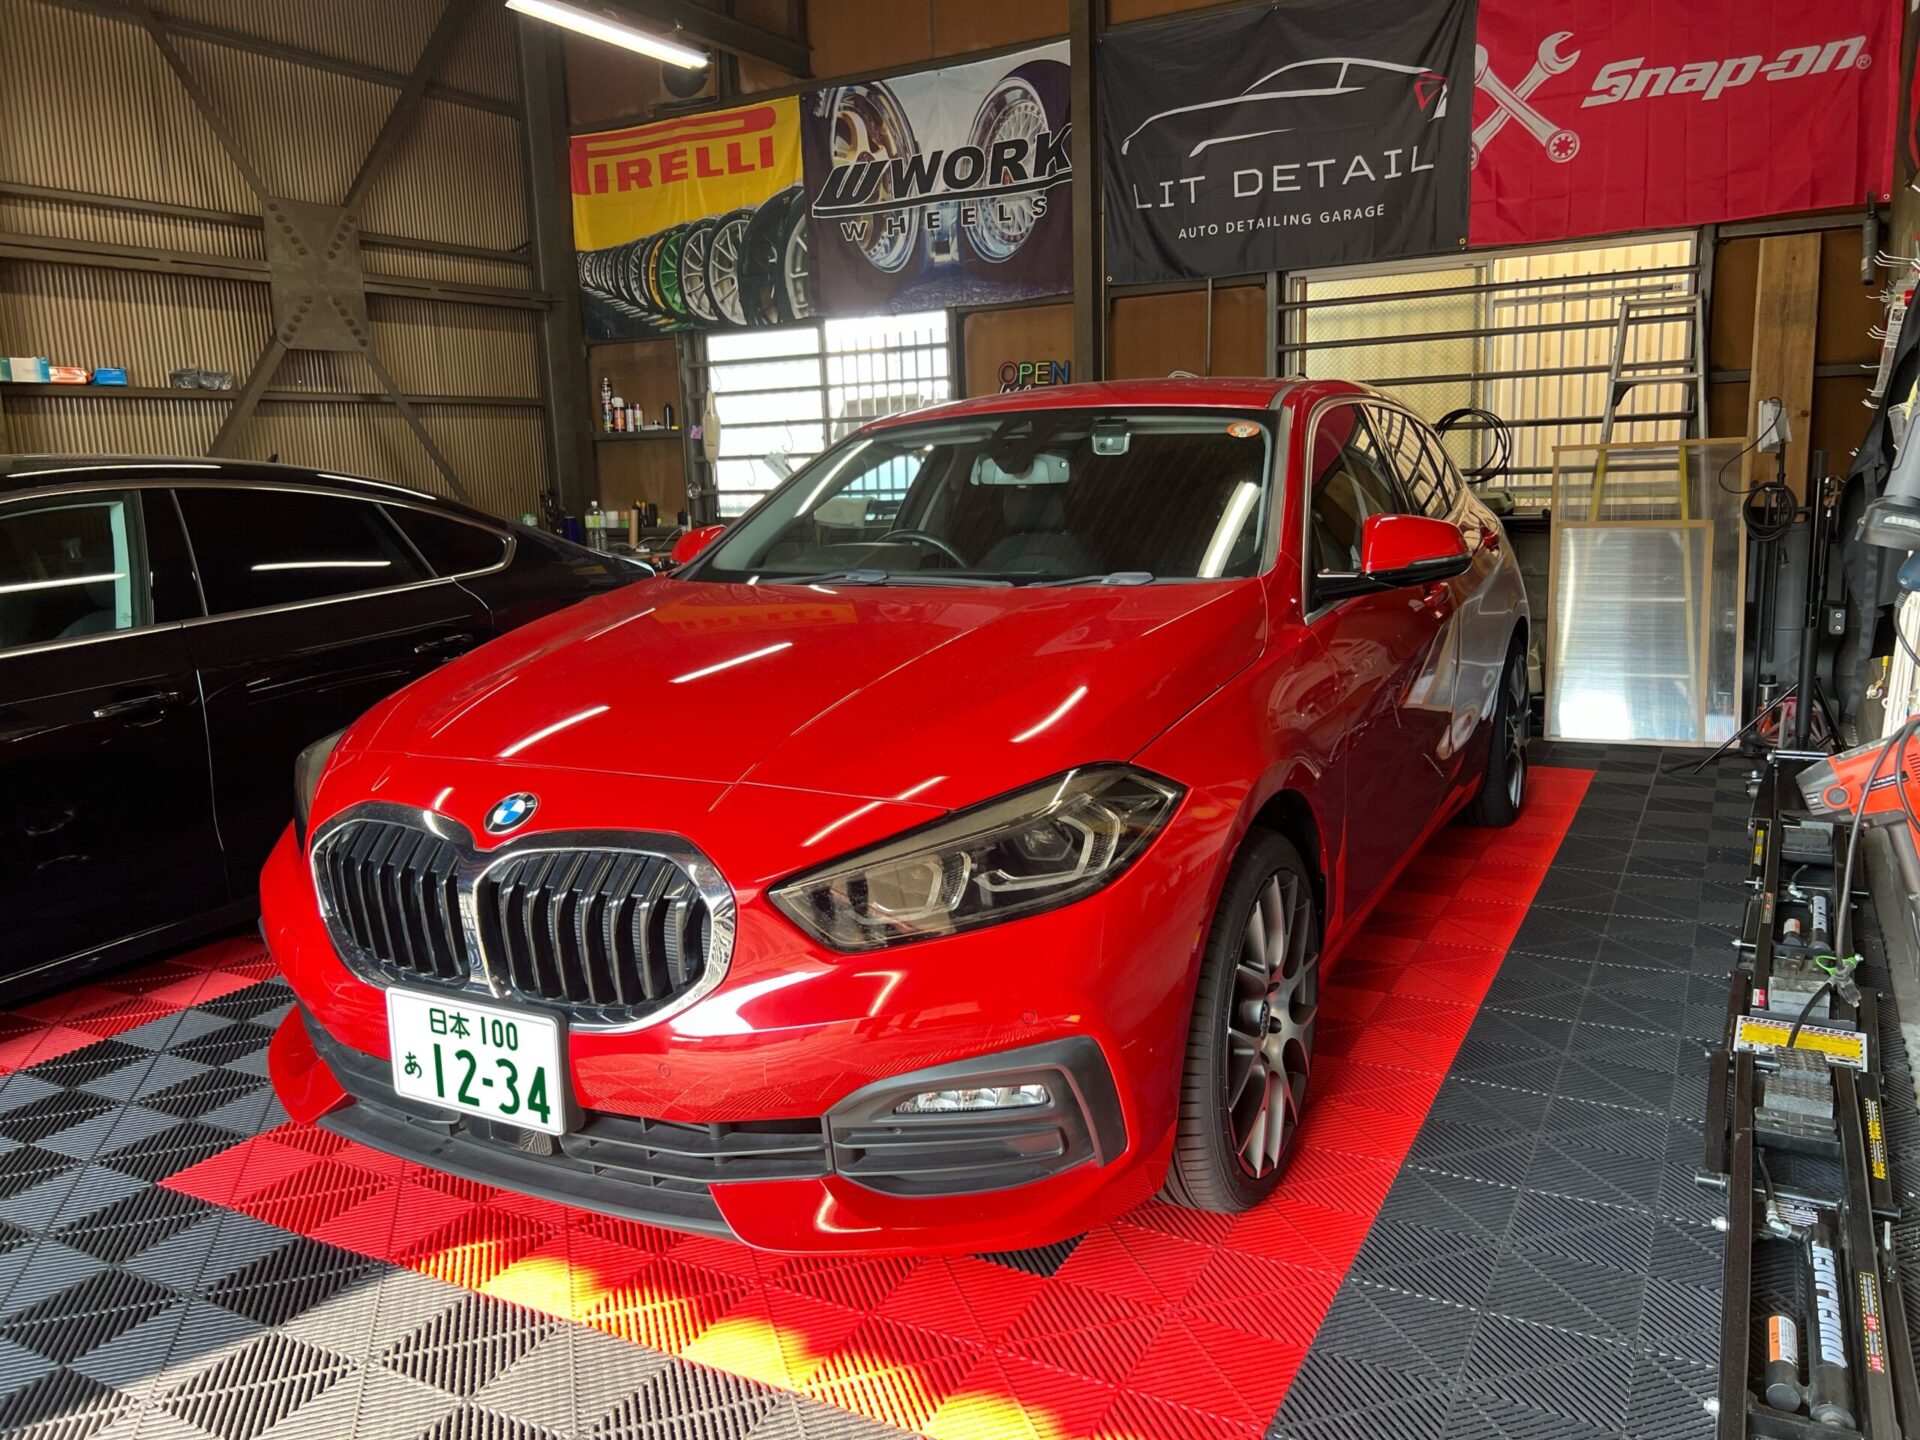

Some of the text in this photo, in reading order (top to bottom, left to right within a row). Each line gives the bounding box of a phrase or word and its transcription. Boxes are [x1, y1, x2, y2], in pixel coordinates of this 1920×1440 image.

[570, 107, 776, 195] PIRELLI
[890, 123, 1072, 200] WORK
[1133, 146, 1434, 208] LIT DETAIL
[841, 196, 1047, 241] WHEELS
[1178, 204, 1385, 239] AUTO DETAILING GARAGE
[998, 360, 1071, 385] OPEN
[429, 1008, 518, 1051] 日本 100
[404, 1043, 550, 1124] あ 12-34
